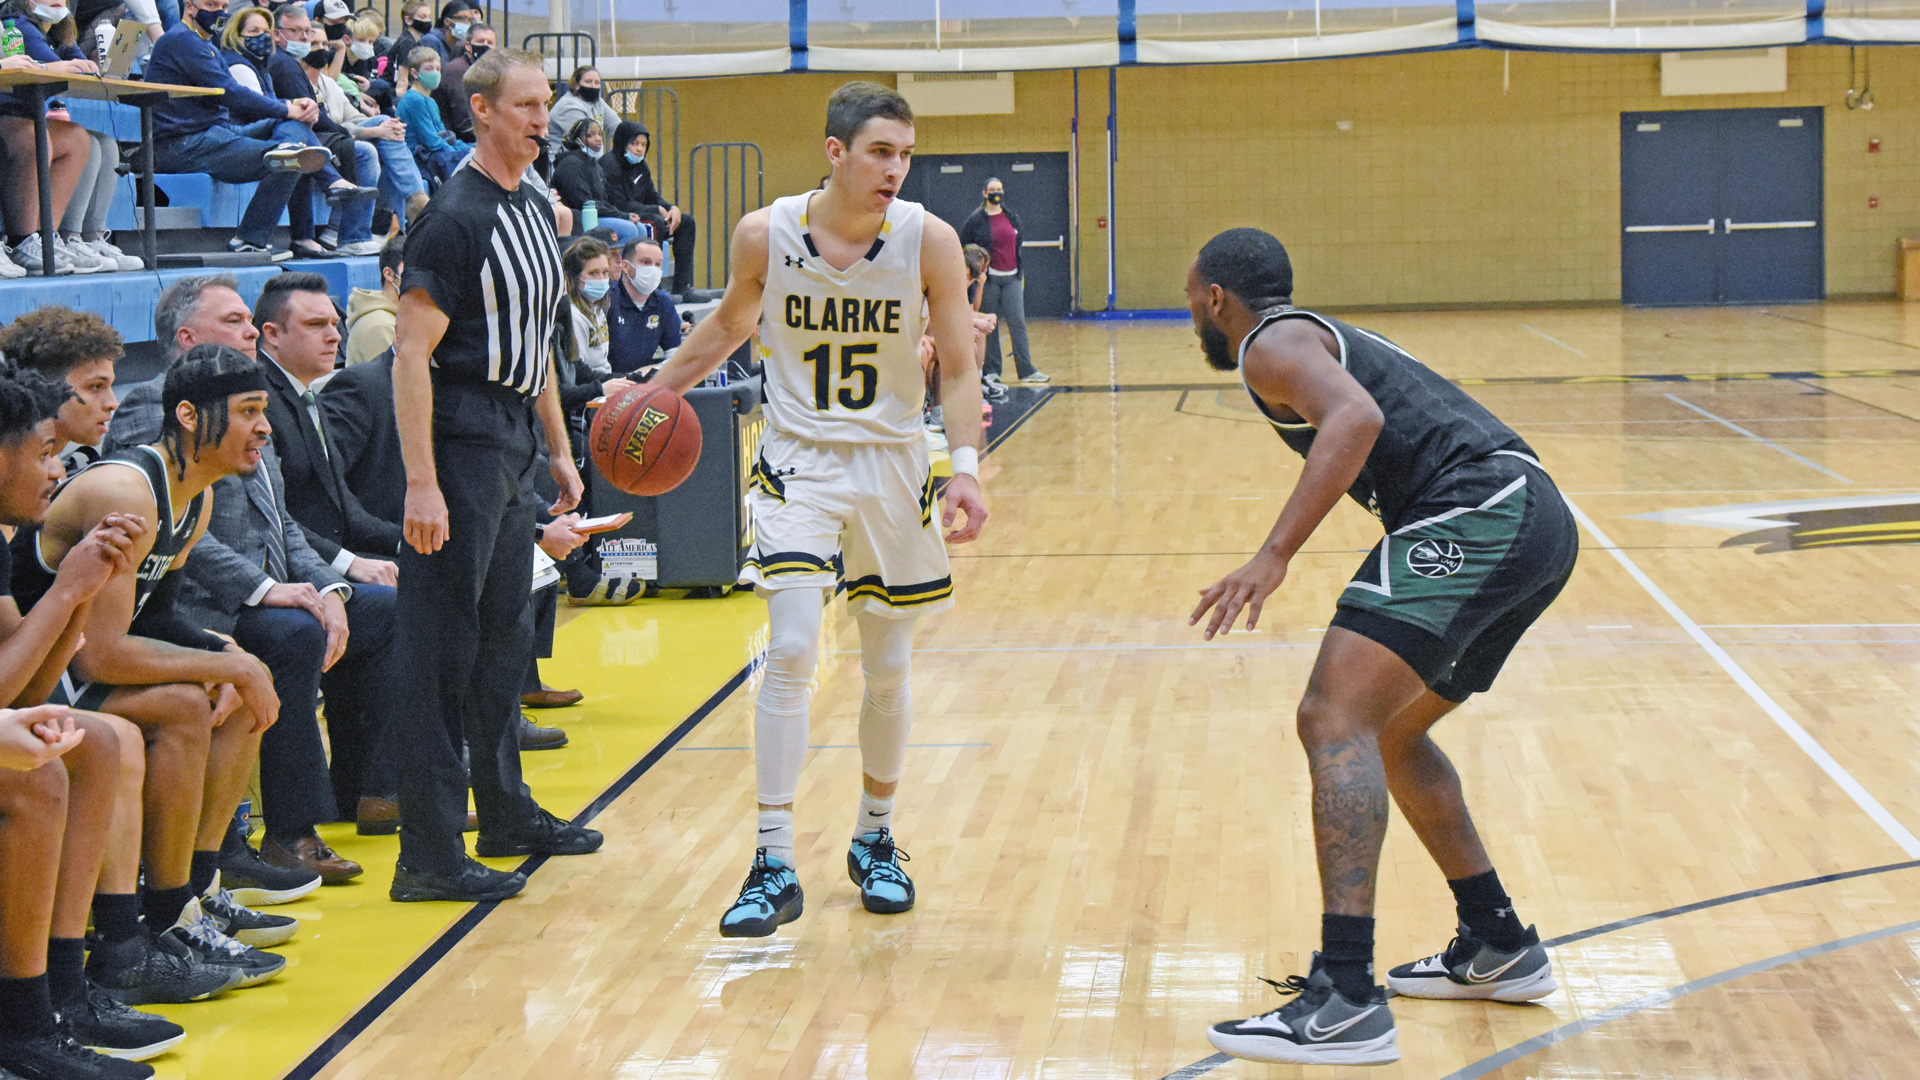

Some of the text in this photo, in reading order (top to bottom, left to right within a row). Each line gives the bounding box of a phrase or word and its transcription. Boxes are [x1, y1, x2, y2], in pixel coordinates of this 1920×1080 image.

[97, 34, 107, 65] CLAR
[785, 294, 901, 334] CLARKE
[802, 342, 879, 412] 15
[622, 405, 669, 465] NAIA
[1440, 558, 1458, 568] CMU
